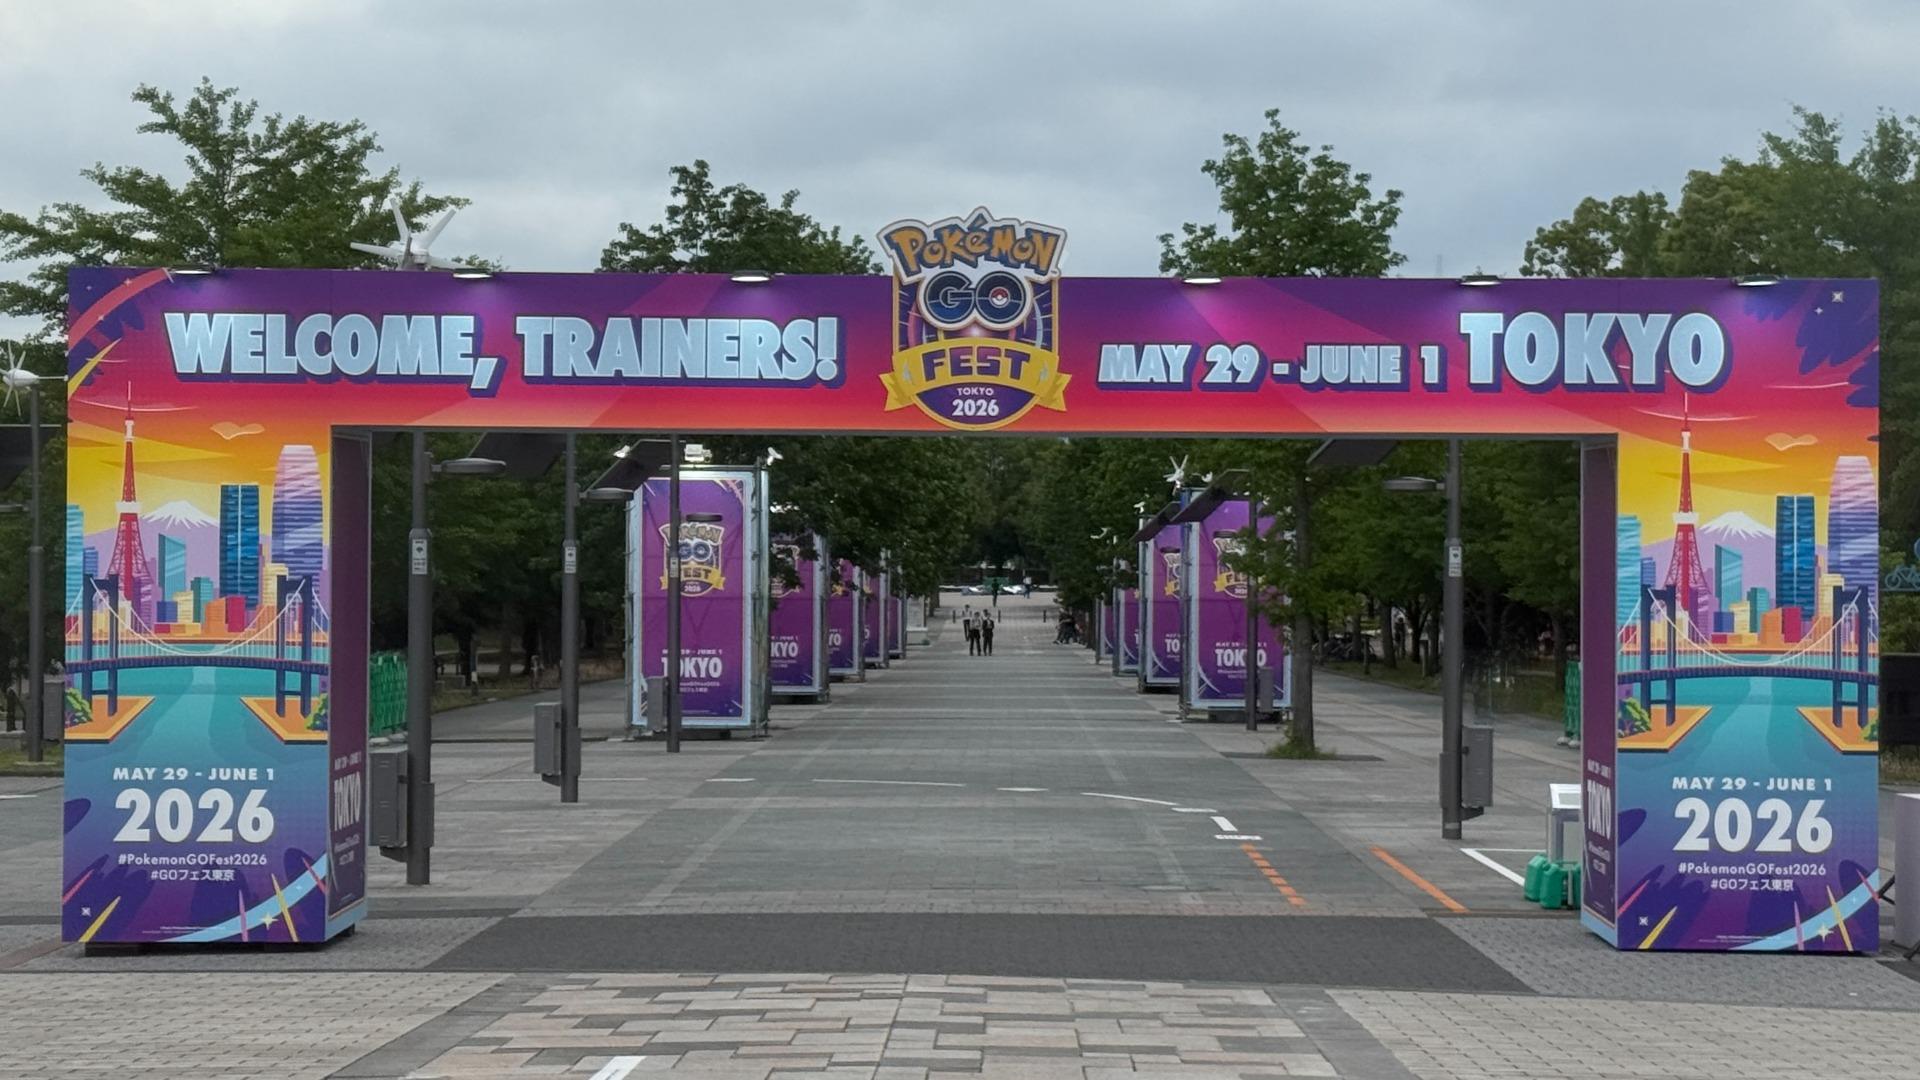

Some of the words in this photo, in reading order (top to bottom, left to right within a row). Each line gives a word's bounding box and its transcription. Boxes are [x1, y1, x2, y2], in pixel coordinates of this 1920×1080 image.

[924, 270, 1027, 324] GO
[163, 311, 499, 390] WELCOME,
[515, 316, 838, 381] TRAINERS!
[1098, 344, 1192, 383] MAY
[1203, 344, 1260, 383] 29
[1300, 345, 1402, 384] JUNE
[1421, 345, 1440, 384] 1
[1460, 311, 1725, 386] TOKYO
[921, 346, 1031, 382] FEST
[956, 387, 995, 397] TOKYO
[952, 399, 1000, 417] 2026
[1215, 649, 1266, 667] TOKO
[113, 767, 156, 780] MAY
[163, 768, 188, 780] 29
[208, 768, 258, 780] JUNE
[266, 768, 274, 780] 1
[1672, 777, 1715, 790] MAY
[1721, 777, 1747, 790] 29
[1766, 778, 1816, 791] JUNE
[1824, 778, 1832, 791] 1
[113, 788, 274, 843] 2026
[1672, 797, 1833, 853] 2026
[118, 853, 268, 866] #PokemonGOFest2026
[151, 869, 235, 881] #GOフェス東京
[1678, 862, 1827, 876] #PokemonGOFest2026
[1710, 878, 1794, 891] #GOフェス東京
